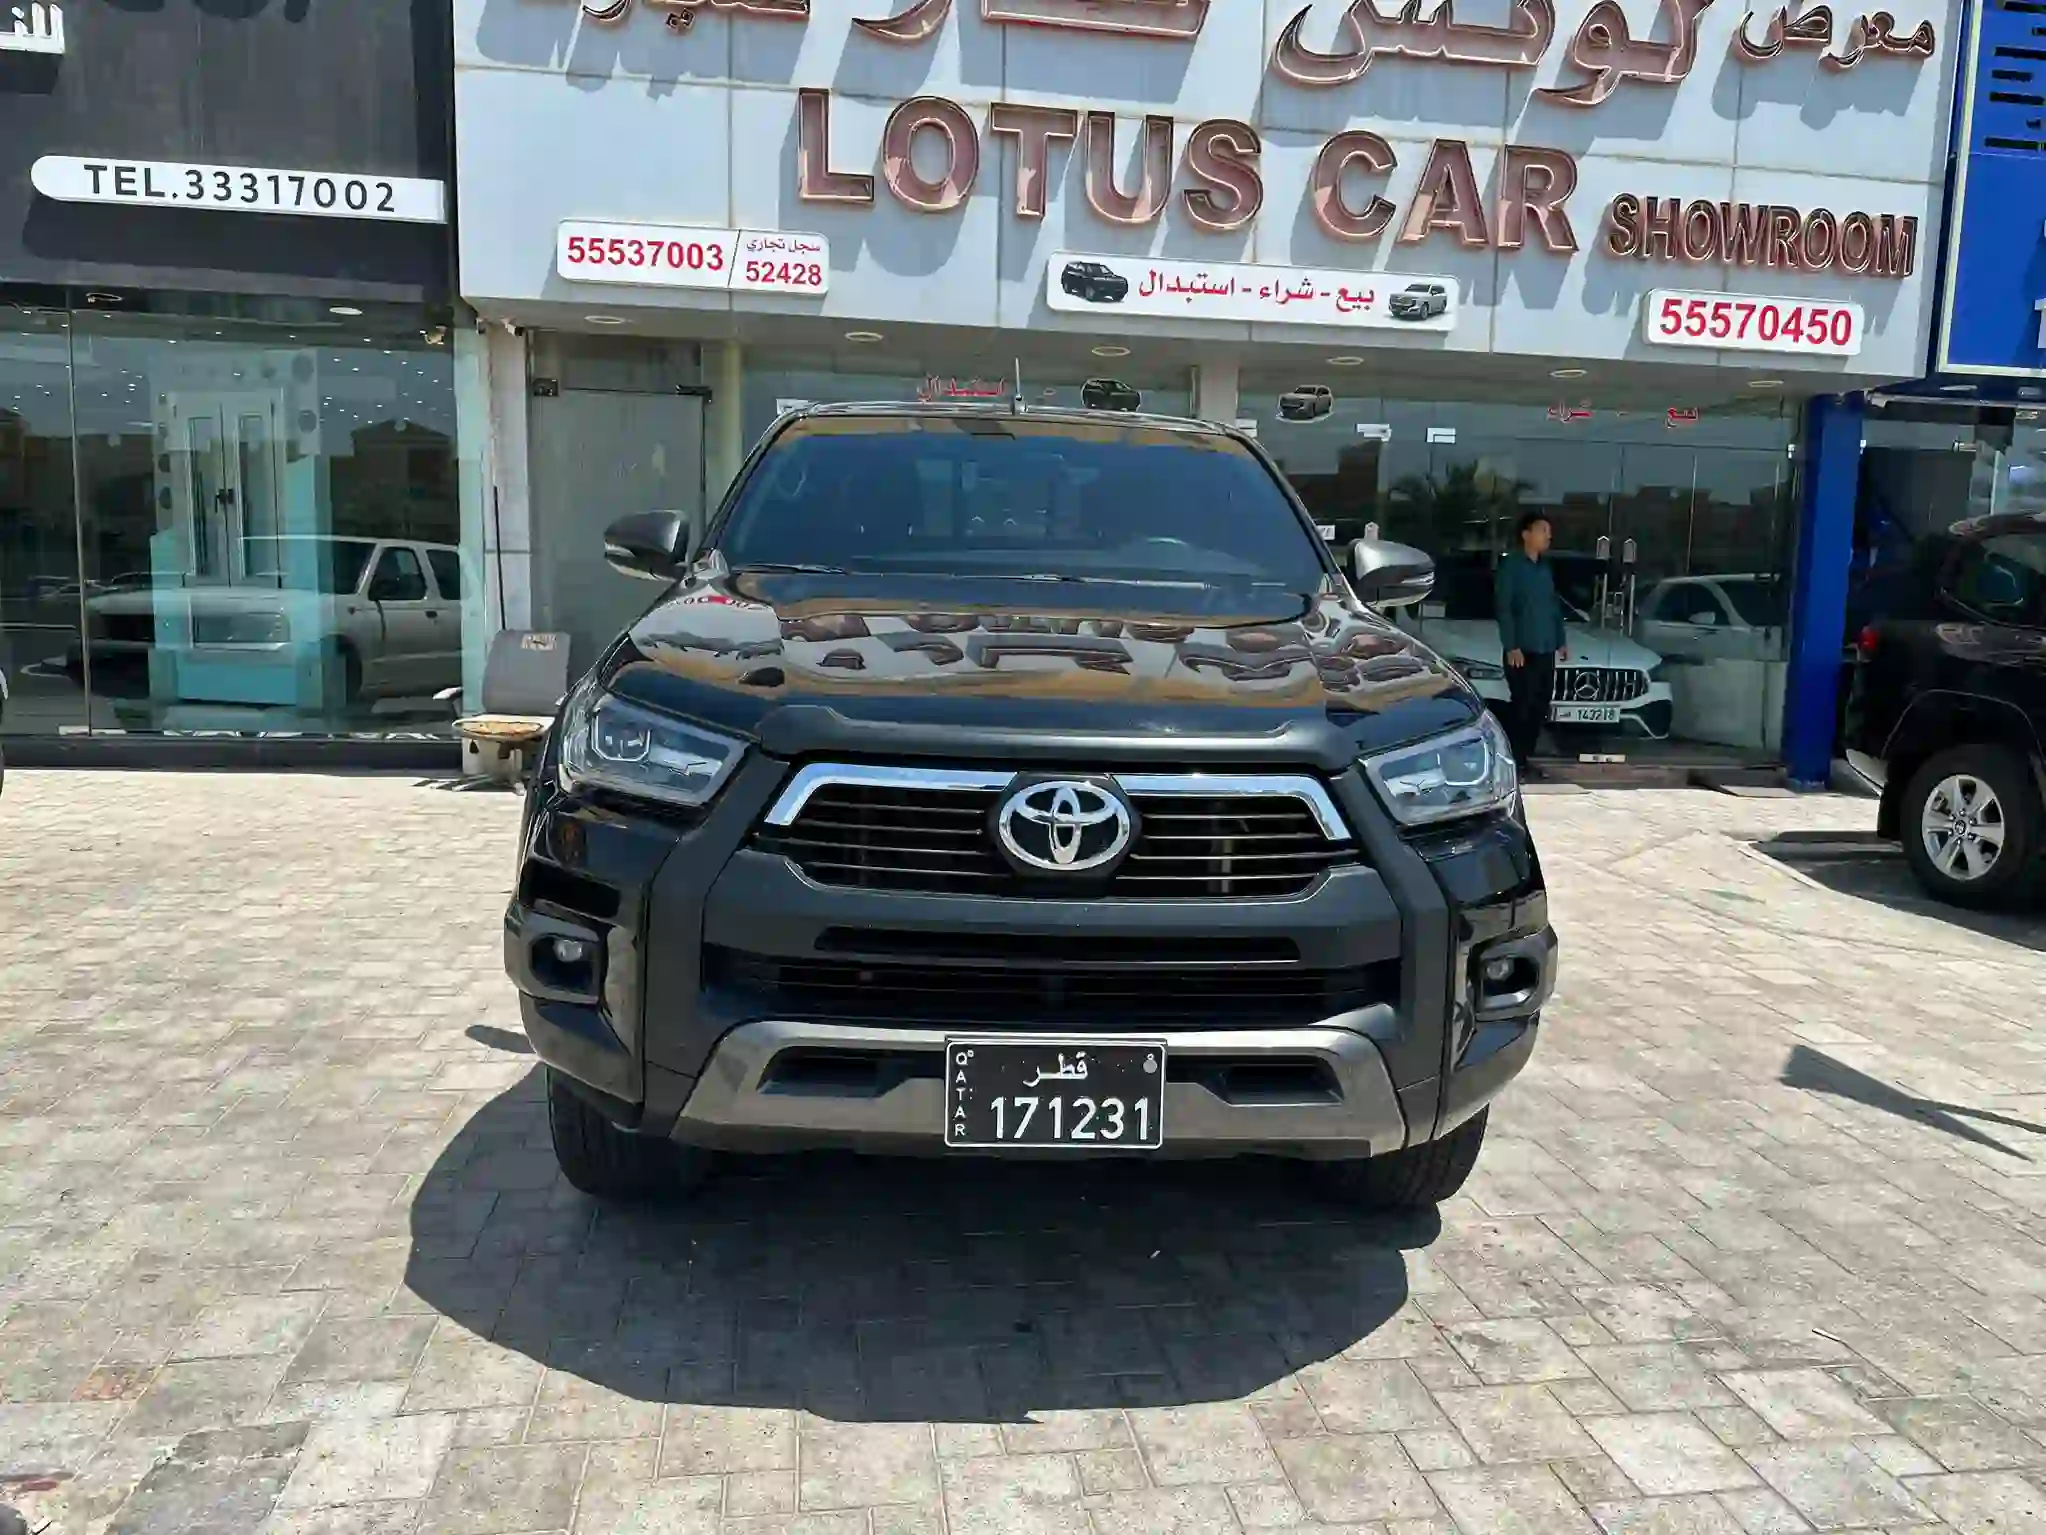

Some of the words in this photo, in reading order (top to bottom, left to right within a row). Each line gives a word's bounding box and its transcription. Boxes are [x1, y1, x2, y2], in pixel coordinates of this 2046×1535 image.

[1739, 5, 1936, 69] معرض
[83, 164, 395, 213] TEL.33317002
[799, 87, 1264, 231] LOTUS
[1312, 130, 1579, 253] CAR
[1607, 192, 1919, 278] SHOWROOM
[567, 236, 724, 271] 55537003
[746, 238, 785, 252] تجاري
[788, 239, 821, 254] سجل
[745, 261, 822, 286] 52428
[1138, 269, 1235, 304] استبدال
[1259, 277, 1314, 305] شراء
[1336, 287, 1375, 313] بيع
[1659, 298, 1851, 346] 55570450
[1022, 1051, 1088, 1087] قطر
[990, 1096, 1149, 1140] 171231
